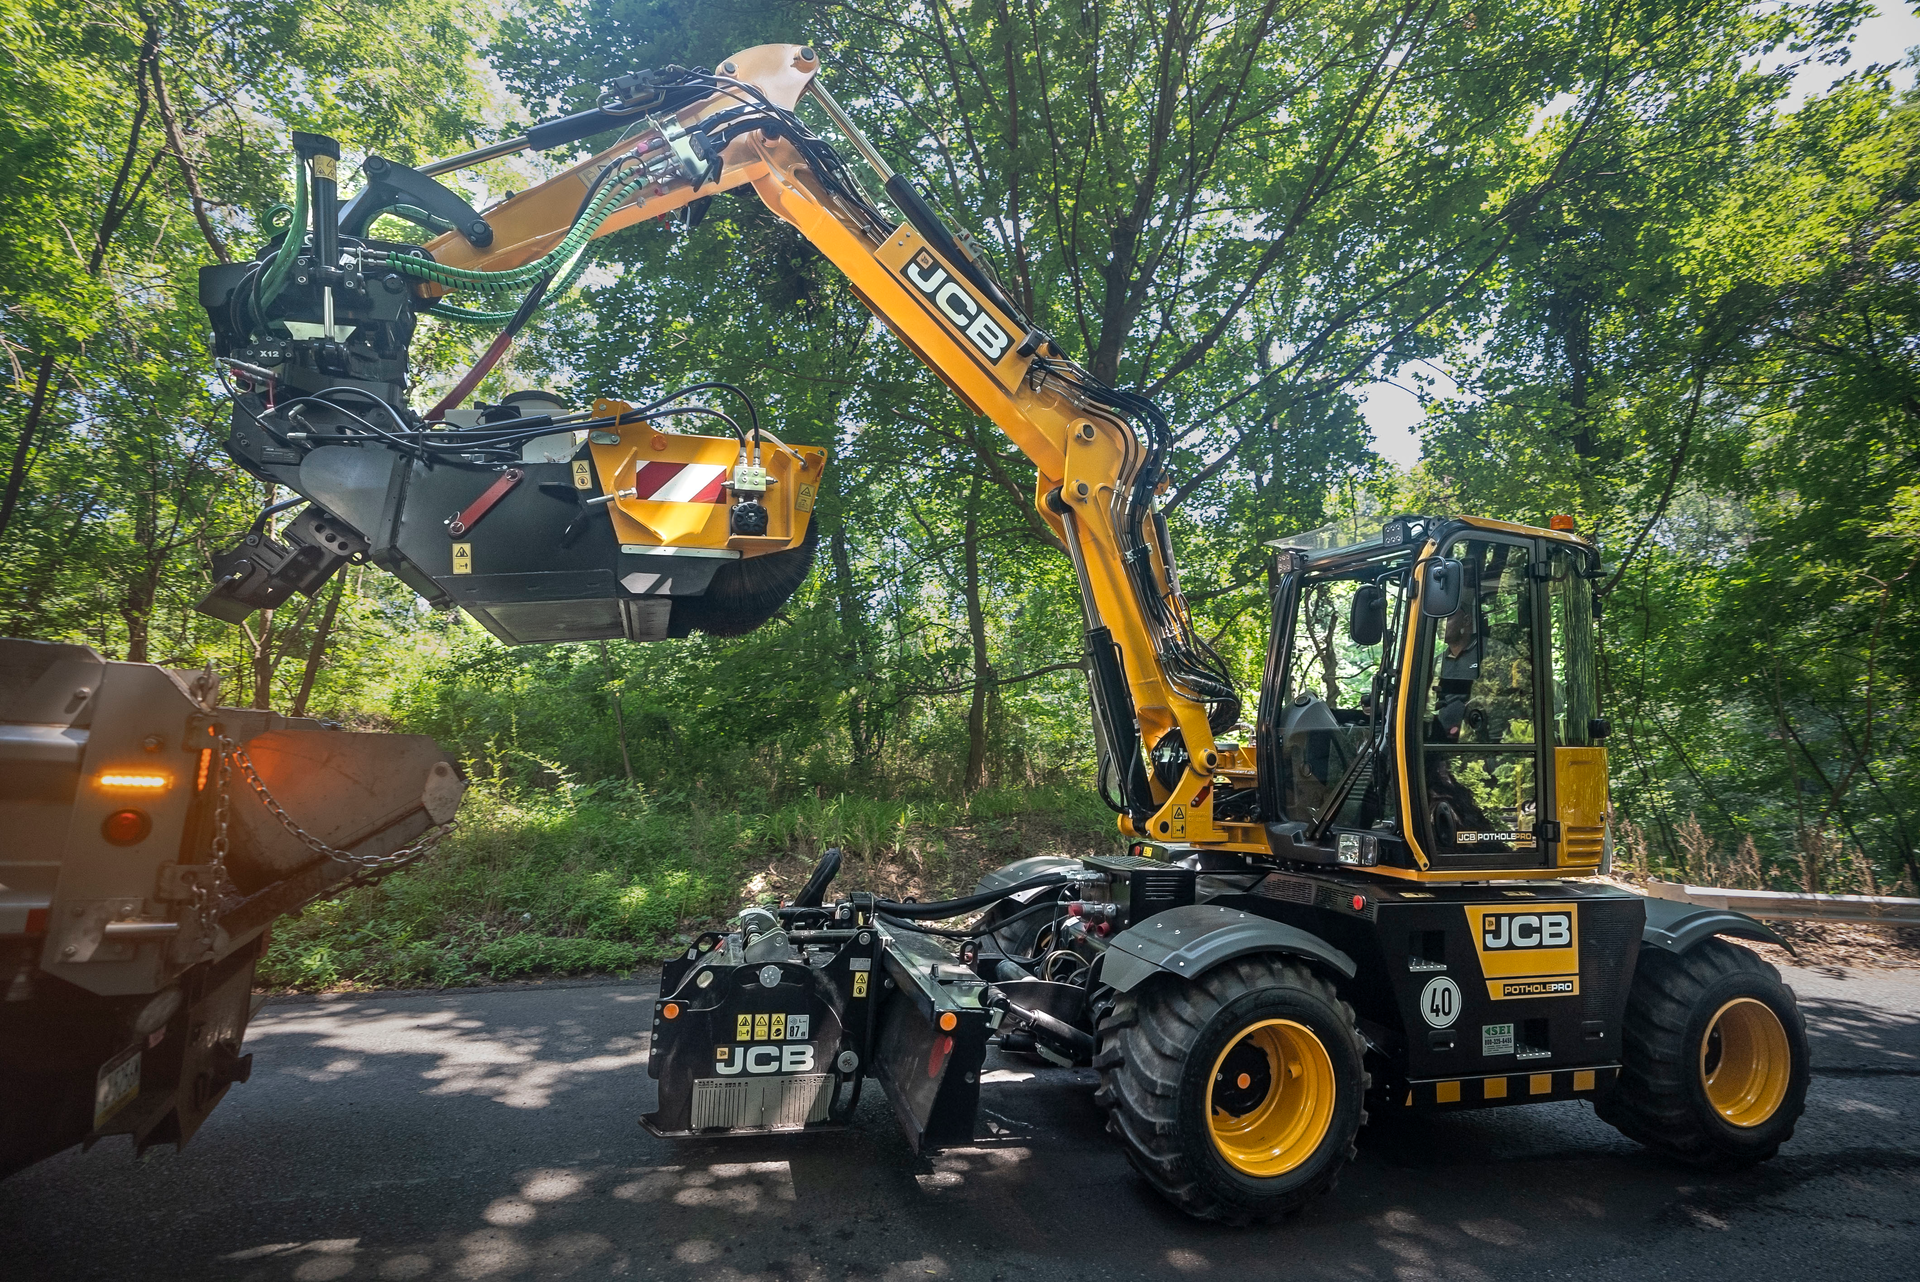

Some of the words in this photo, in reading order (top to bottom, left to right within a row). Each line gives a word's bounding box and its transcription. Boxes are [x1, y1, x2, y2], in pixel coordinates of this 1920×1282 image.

[907, 262, 1008, 359] JCB
[260, 350, 280, 358] X12
[1458, 833, 1476, 842] JCB
[1485, 914, 1571, 949] JCB
[1430, 987, 1452, 1018] 40
[789, 1025, 800, 1038] 87
[1491, 1025, 1512, 1036] SEI
[715, 1044, 815, 1075] JCB
